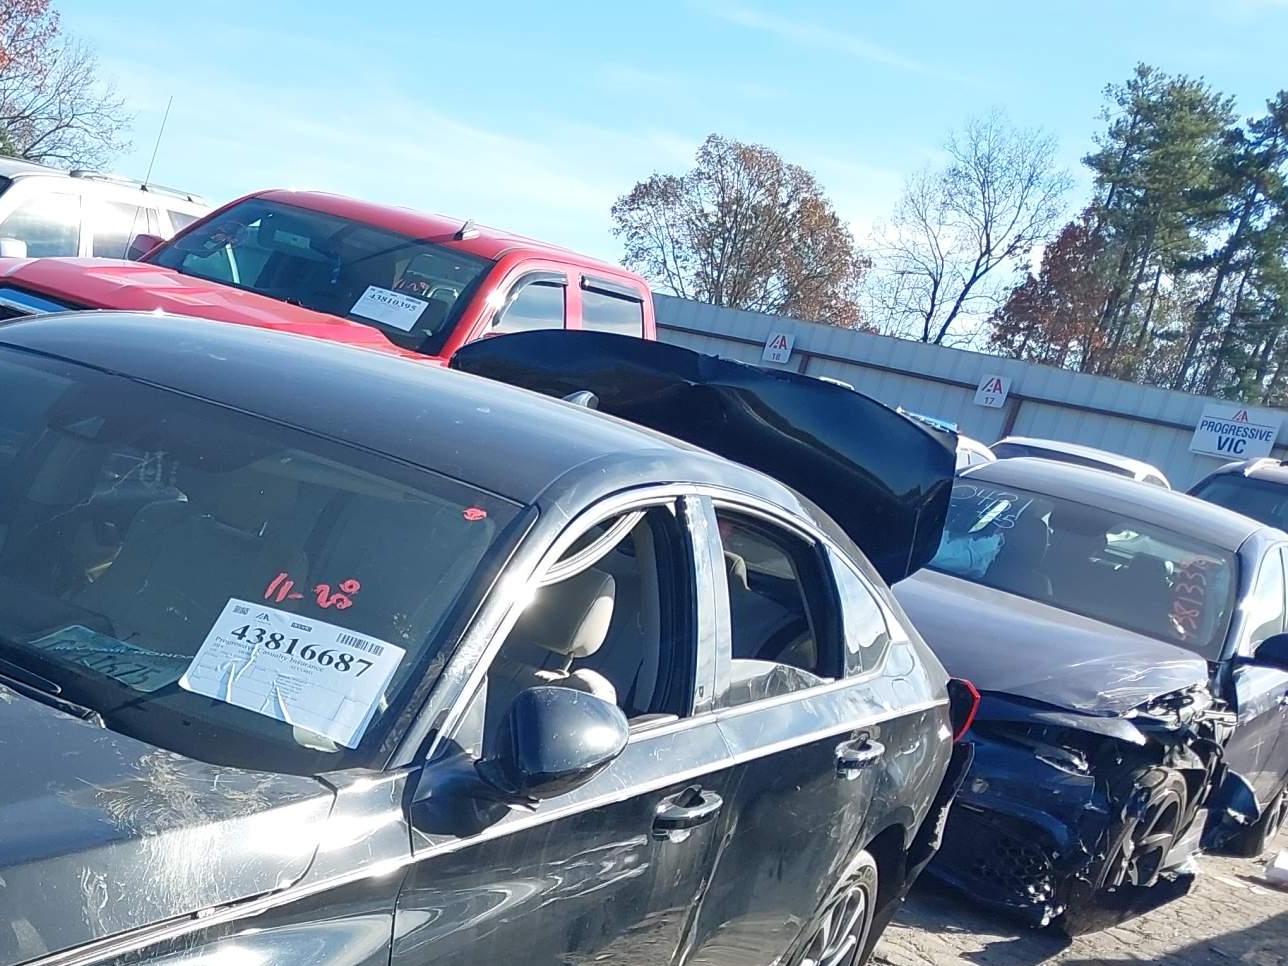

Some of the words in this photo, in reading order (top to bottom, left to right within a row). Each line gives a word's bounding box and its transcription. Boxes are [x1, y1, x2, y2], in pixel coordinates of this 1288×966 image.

[984, 396, 996, 405] 17
[1199, 419, 1274, 442] PROGRESSIVE
[1216, 436, 1247, 455] VIC
[230, 624, 375, 678] 43816687
